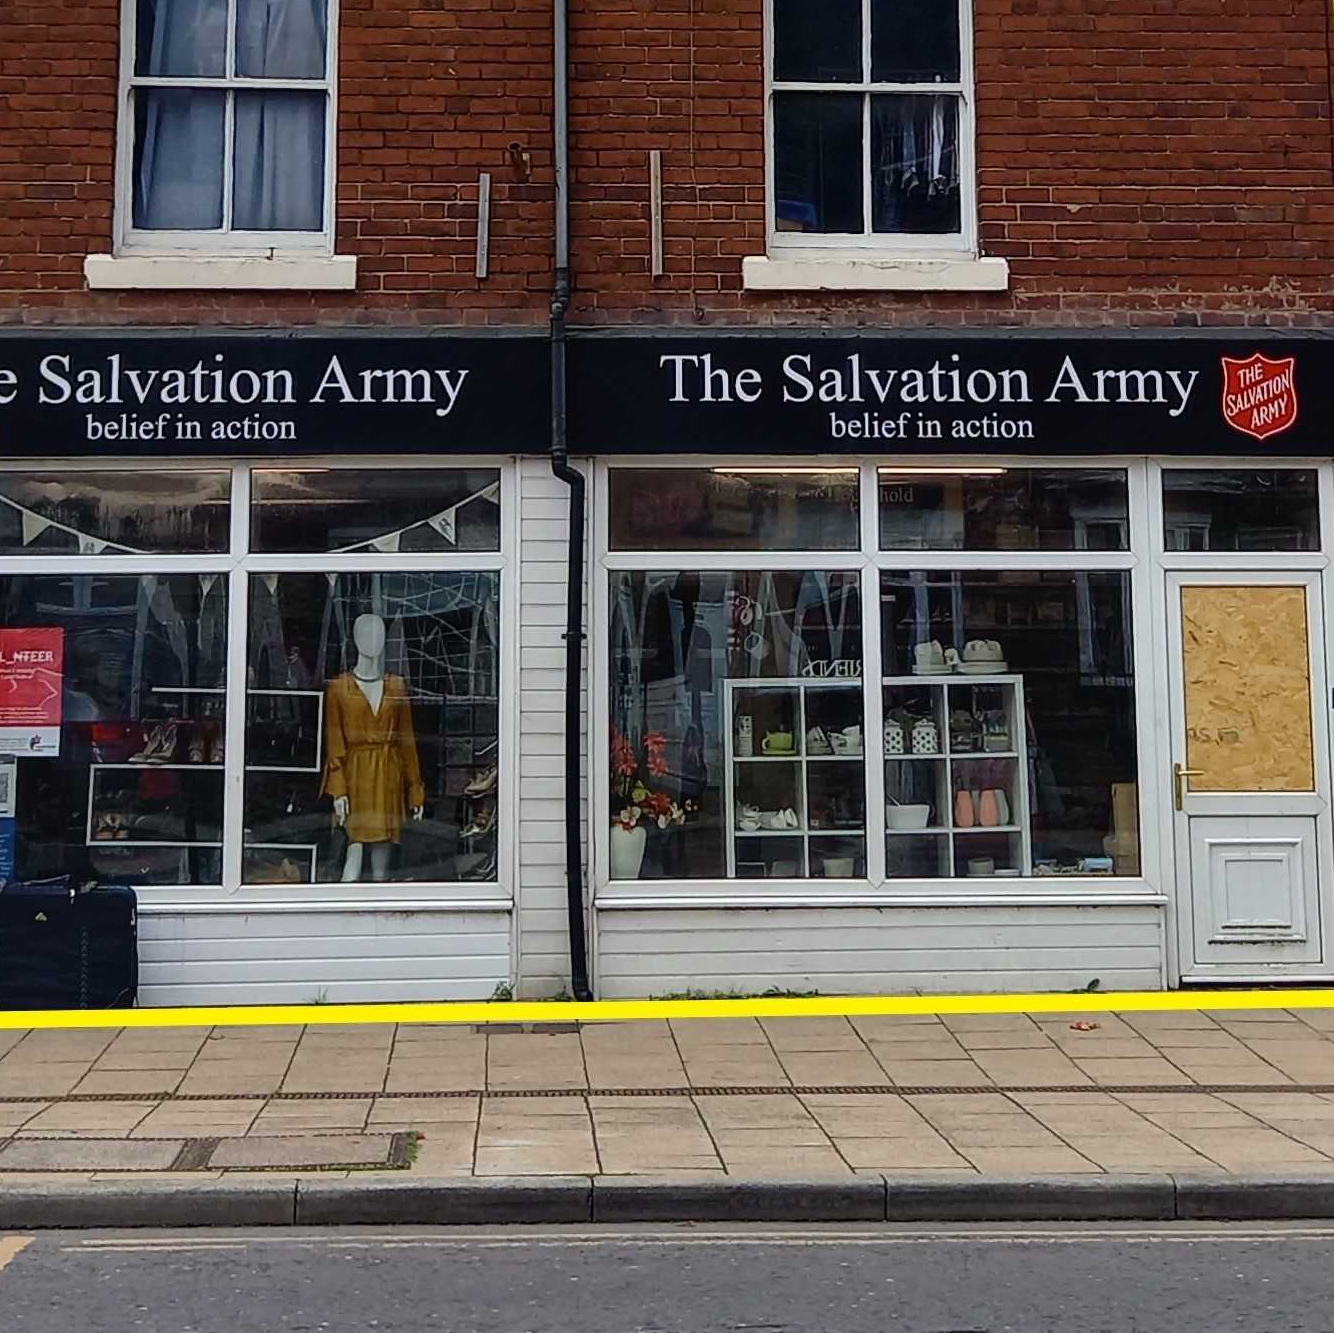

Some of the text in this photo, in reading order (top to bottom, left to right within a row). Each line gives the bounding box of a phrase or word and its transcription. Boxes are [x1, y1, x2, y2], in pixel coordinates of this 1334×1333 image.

[39, 354, 296, 404] Salvation
[310, 355, 469, 416] Army
[660, 354, 1199, 416] The Salvation Army
[1227, 369, 1289, 417] SALVATION
[1237, 363, 1264, 388] THE
[86, 414, 297, 440] belief in action
[830, 412, 1035, 438] belief in action
[1251, 393, 1287, 429] ARMY
